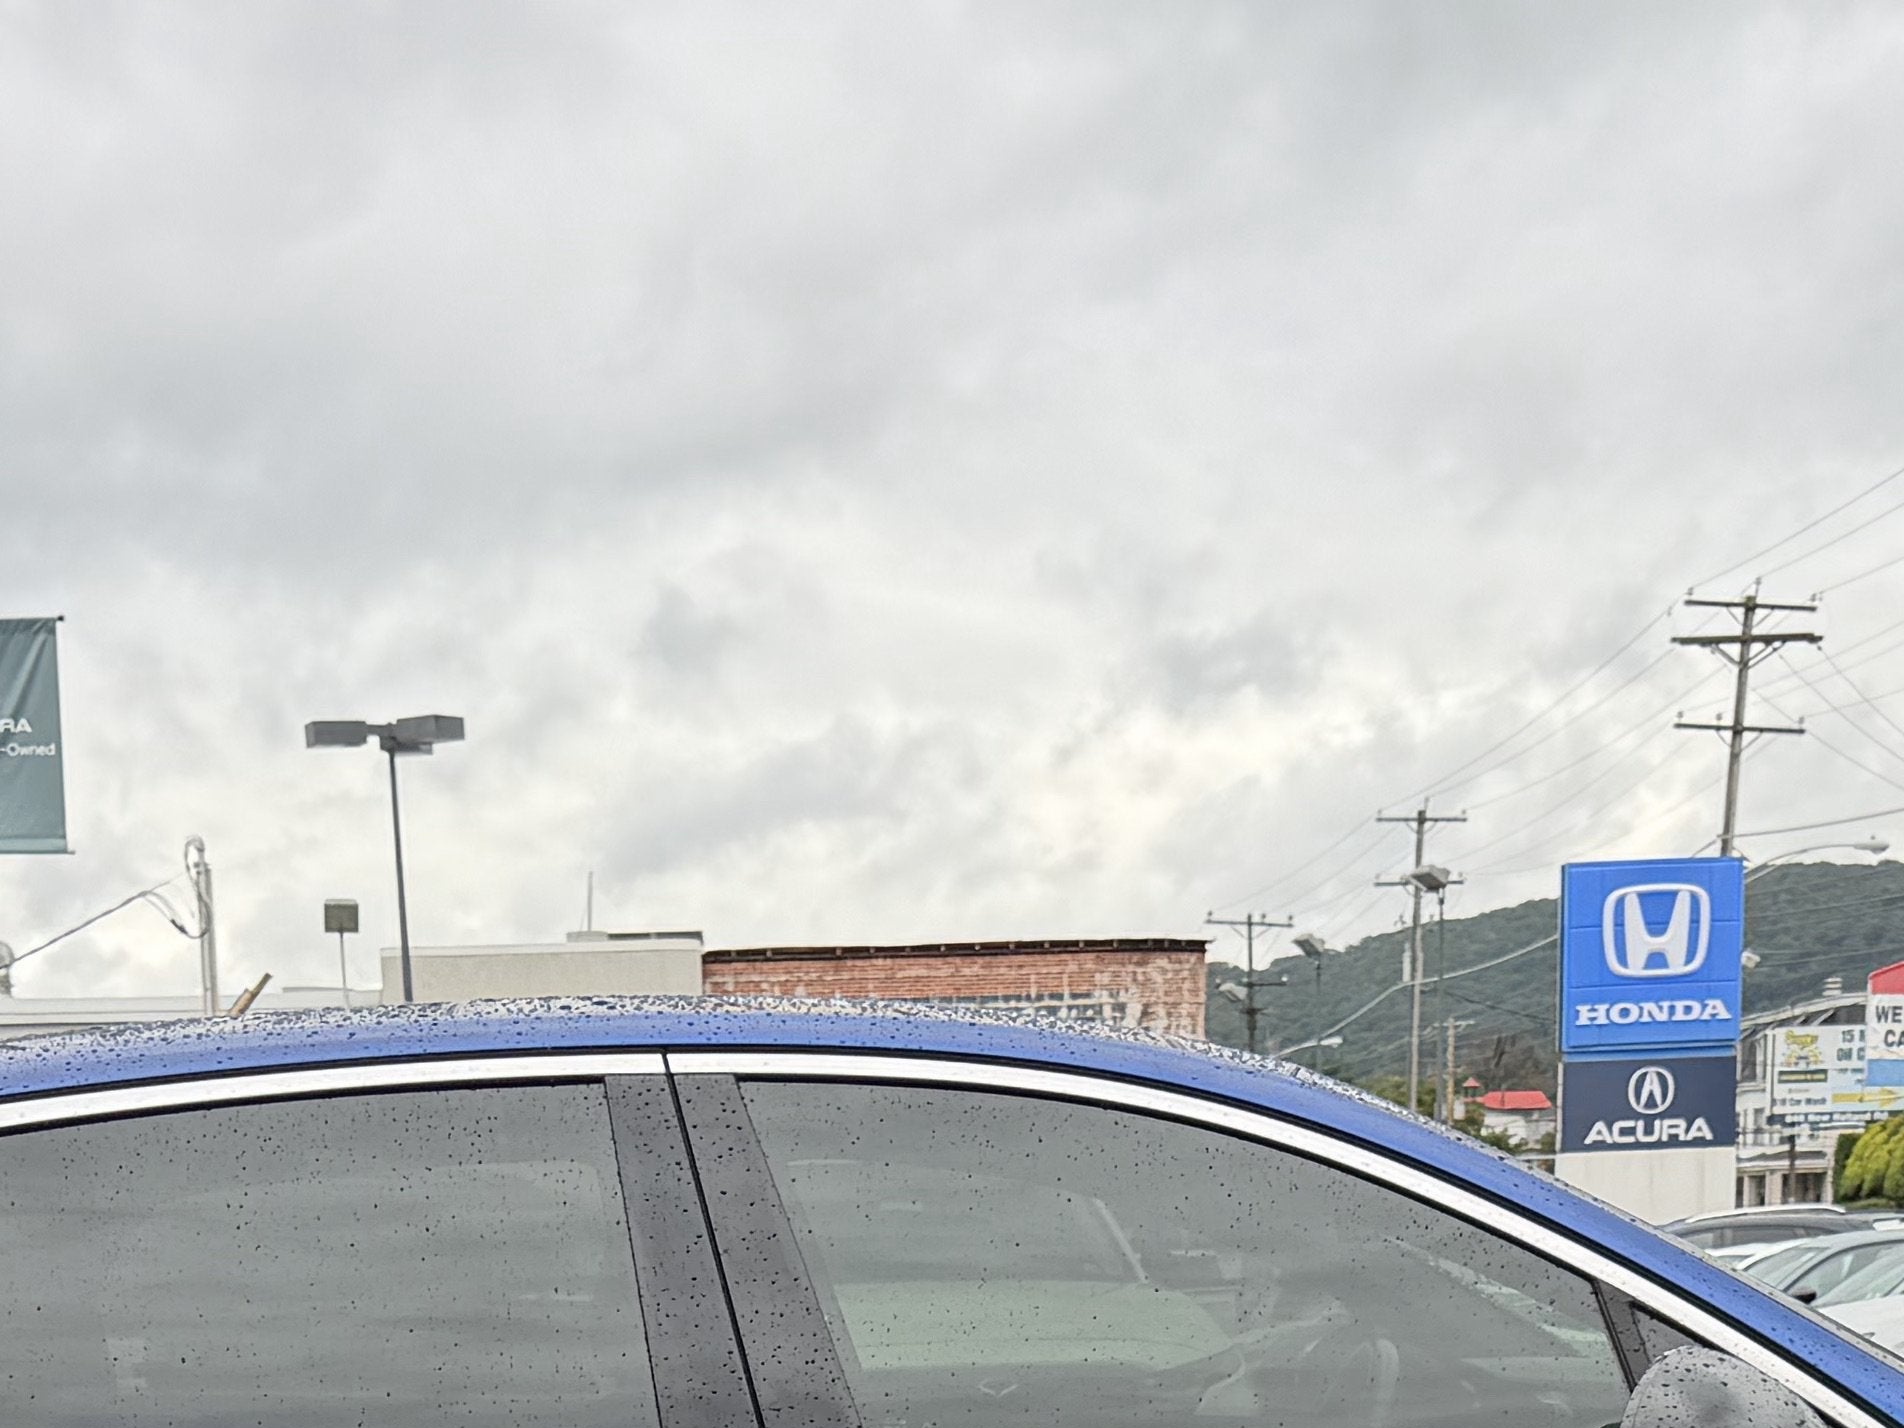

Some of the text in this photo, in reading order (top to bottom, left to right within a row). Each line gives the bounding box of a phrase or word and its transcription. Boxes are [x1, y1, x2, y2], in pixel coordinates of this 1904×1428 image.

[1575, 999, 1733, 1026] HONDA
[1875, 1005, 1903, 1024] WE
[1583, 1117, 1714, 1145] ACURA
